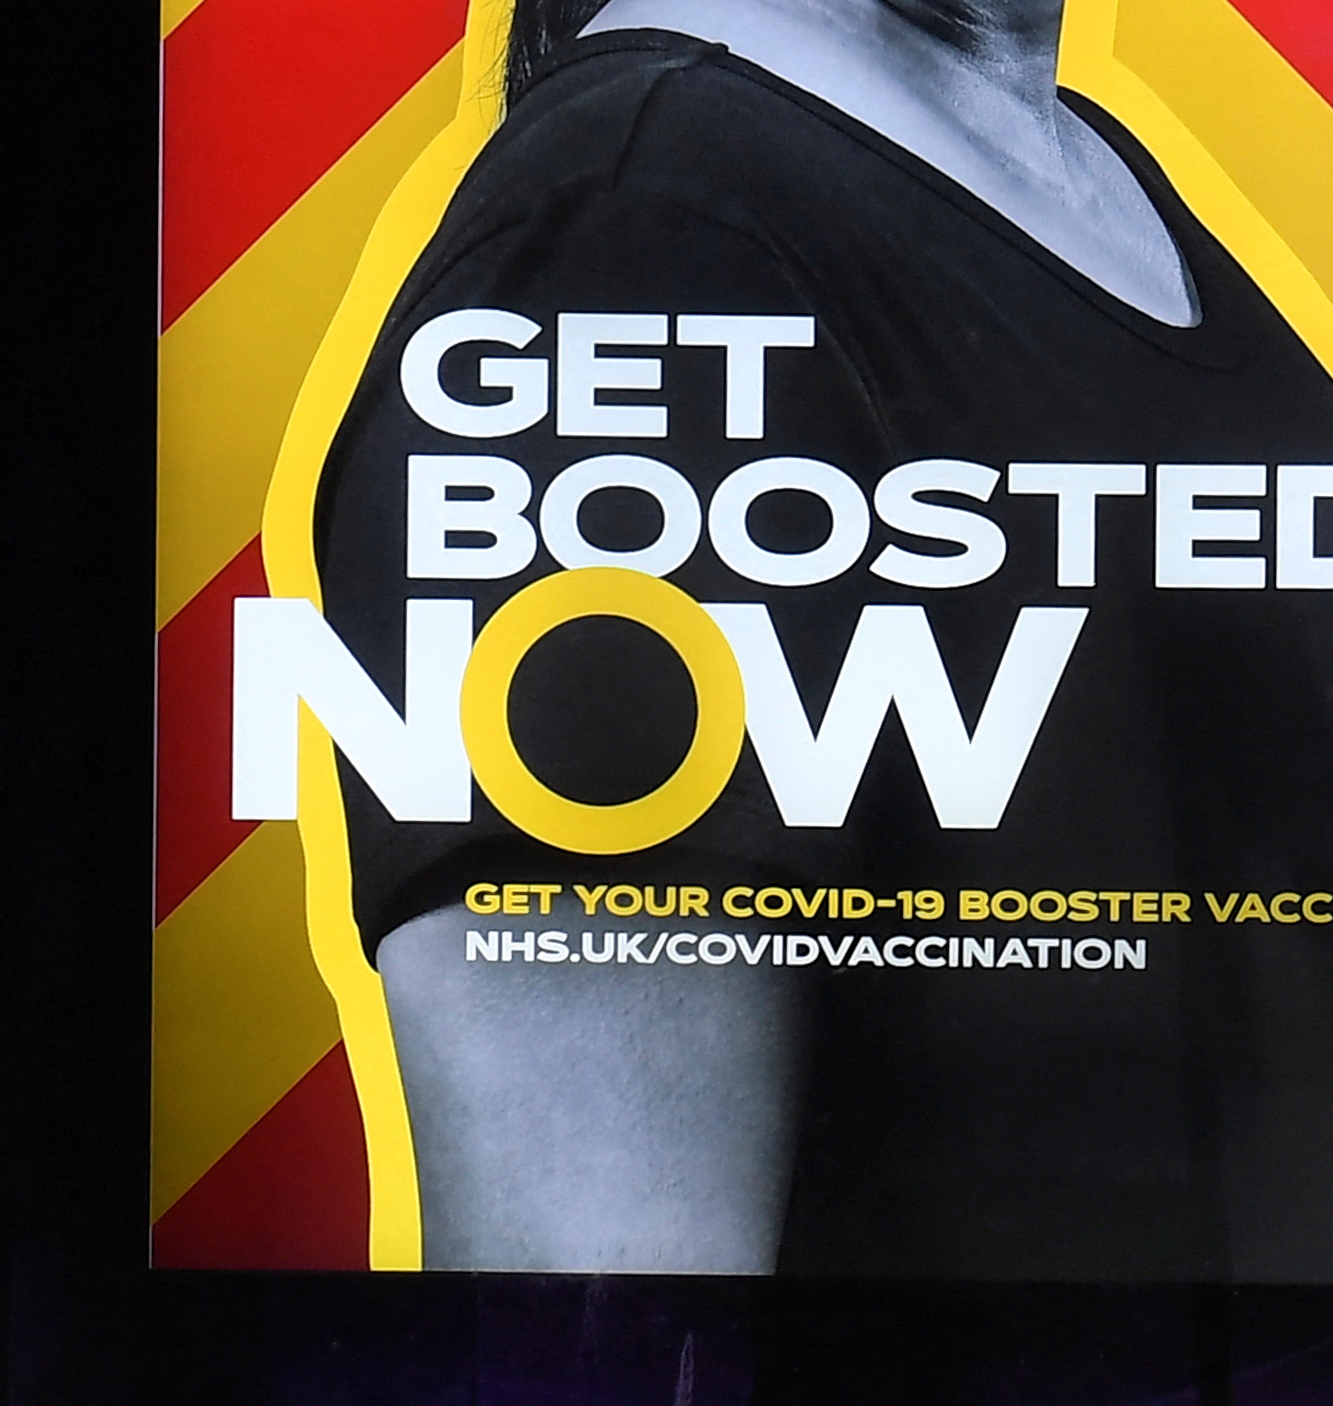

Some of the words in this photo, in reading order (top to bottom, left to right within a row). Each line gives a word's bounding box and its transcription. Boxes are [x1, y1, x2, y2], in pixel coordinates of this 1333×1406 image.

[398, 307, 817, 441] GET
[231, 566, 1091, 856] NOW
[464, 882, 562, 916] GET
[573, 884, 710, 917] YOUR
[721, 887, 946, 920] COVID-19
[958, 889, 1192, 922] BOOSTER
[465, 929, 1147, 971] NHS.UK/COVIDVACCINATION
